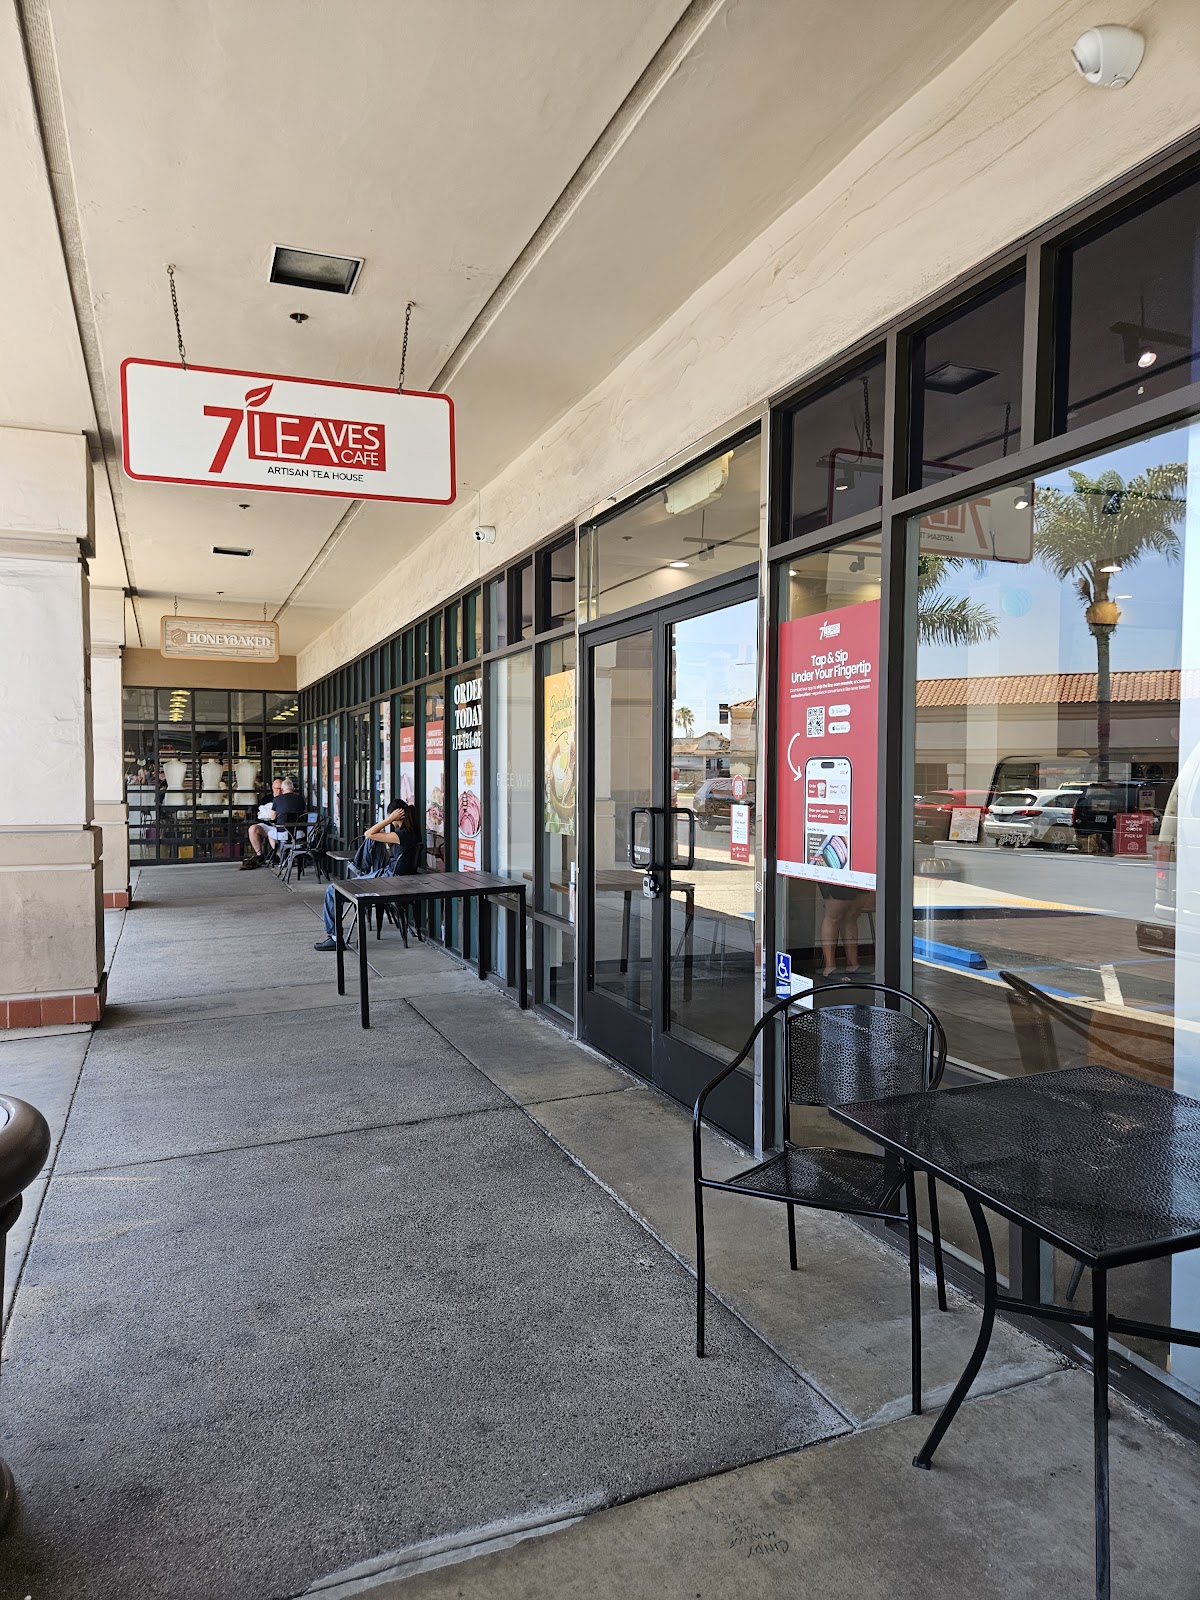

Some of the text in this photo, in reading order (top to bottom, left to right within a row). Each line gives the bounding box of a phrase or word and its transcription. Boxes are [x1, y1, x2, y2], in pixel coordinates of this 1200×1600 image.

[203, 405, 380, 474] 7 LEAVES
[340, 449, 379, 467] CAFE
[267, 466, 364, 482] ARTISAN TEA HOUSE
[186, 633, 271, 647] HONEYBAKED
[811, 649, 849, 669] Tap & Sip
[791, 660, 871, 684] Under Your Fingertip
